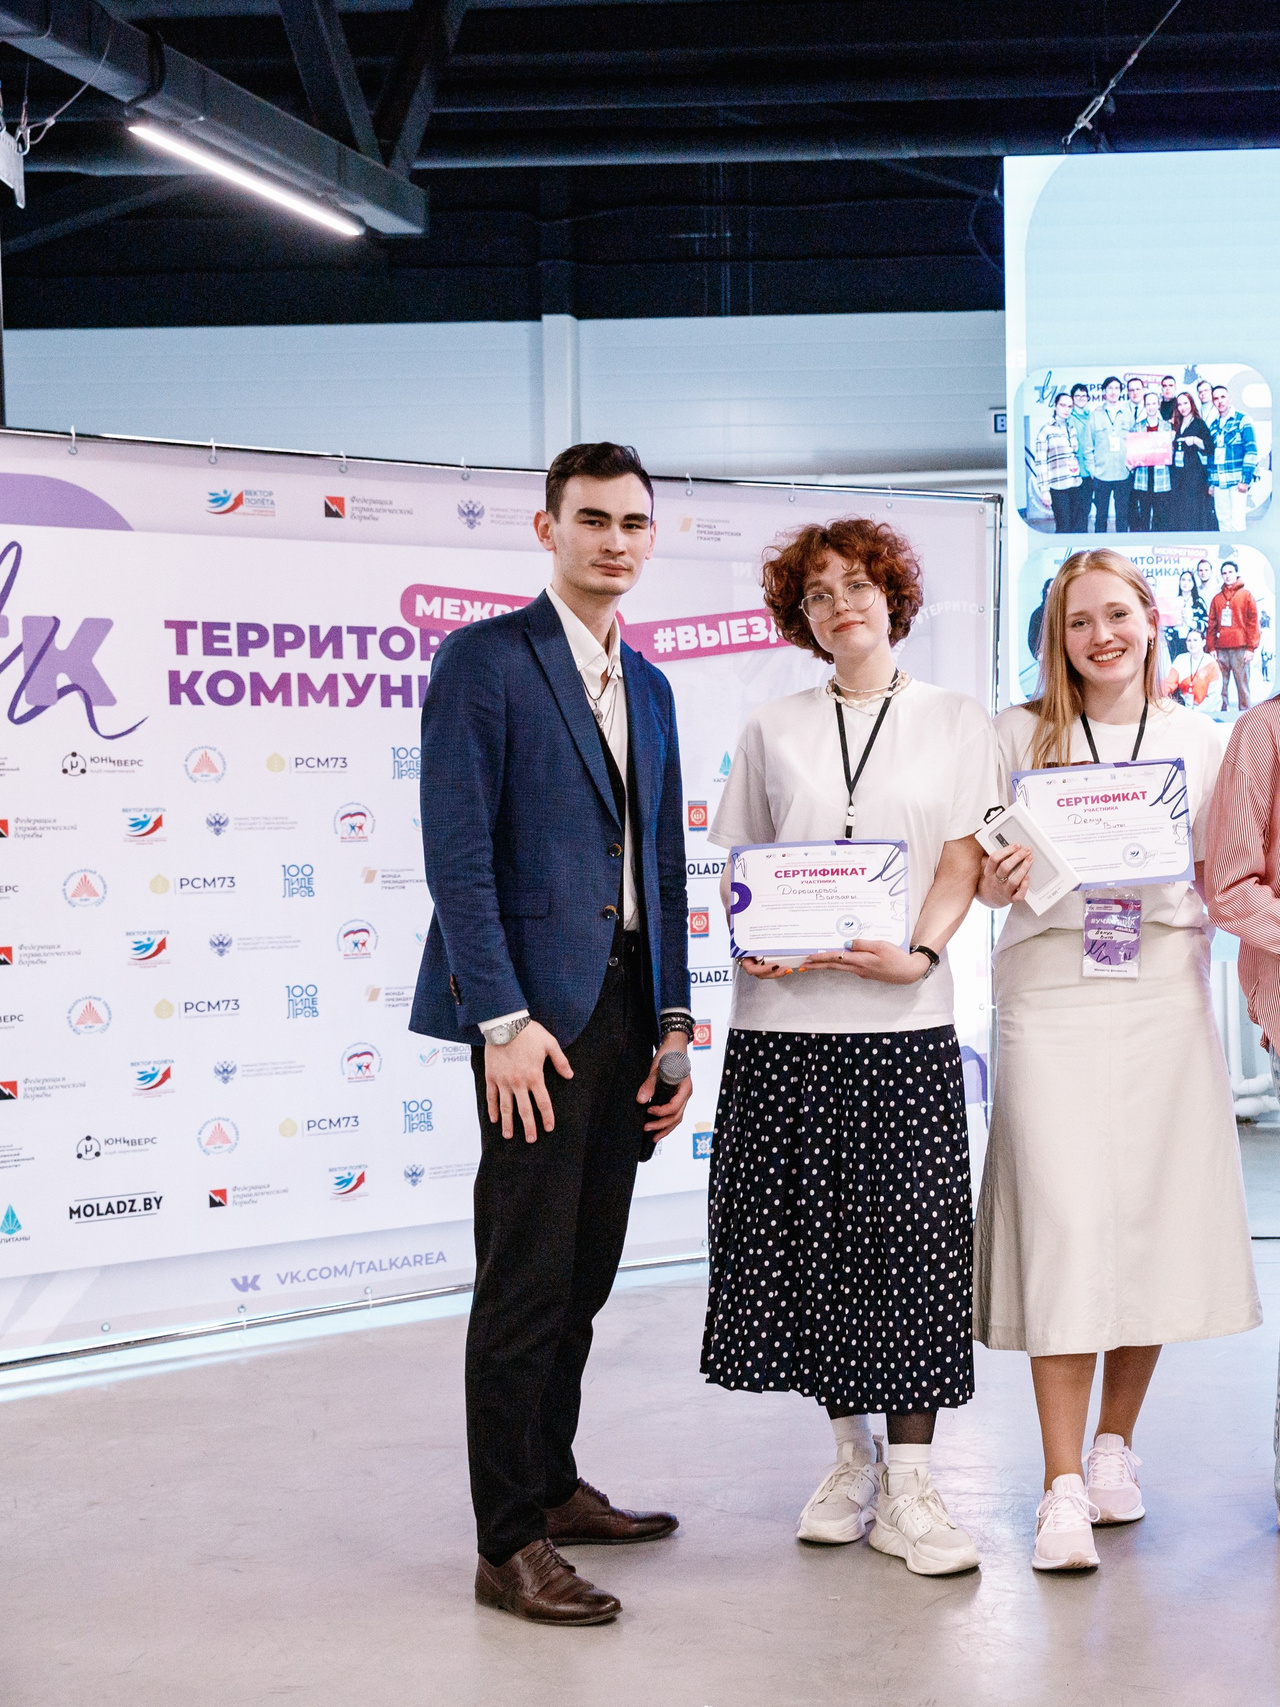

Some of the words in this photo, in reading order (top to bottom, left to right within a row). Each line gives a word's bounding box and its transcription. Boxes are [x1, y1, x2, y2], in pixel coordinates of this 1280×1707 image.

[164, 619, 447, 662] ТЕРРИТОР
[168, 669, 429, 709] КОММУН
[391, 746, 421, 761] 100
[294, 756, 348, 769] РСМ73
[1056, 790, 1148, 808] СЕРТИФИКАТ
[1083, 805, 1119, 814] УЧАСТНИКА
[281, 864, 314, 878] 100
[774, 867, 867, 879] СЕРТИФИКАТ
[179, 876, 236, 890] РСМ73
[286, 984, 318, 998] 100
[183, 998, 240, 1014] РСМ73
[442, 1046, 471, 1054] ПОВОЛ
[442, 1054, 471, 1063] УНИВЕ
[402, 1099, 433, 1114] 100
[307, 1116, 360, 1131] РСМ73
[69, 1196, 164, 1220] MOLADZ.BY
[276, 1250, 447, 1286] VK.COM/TALKAREA
